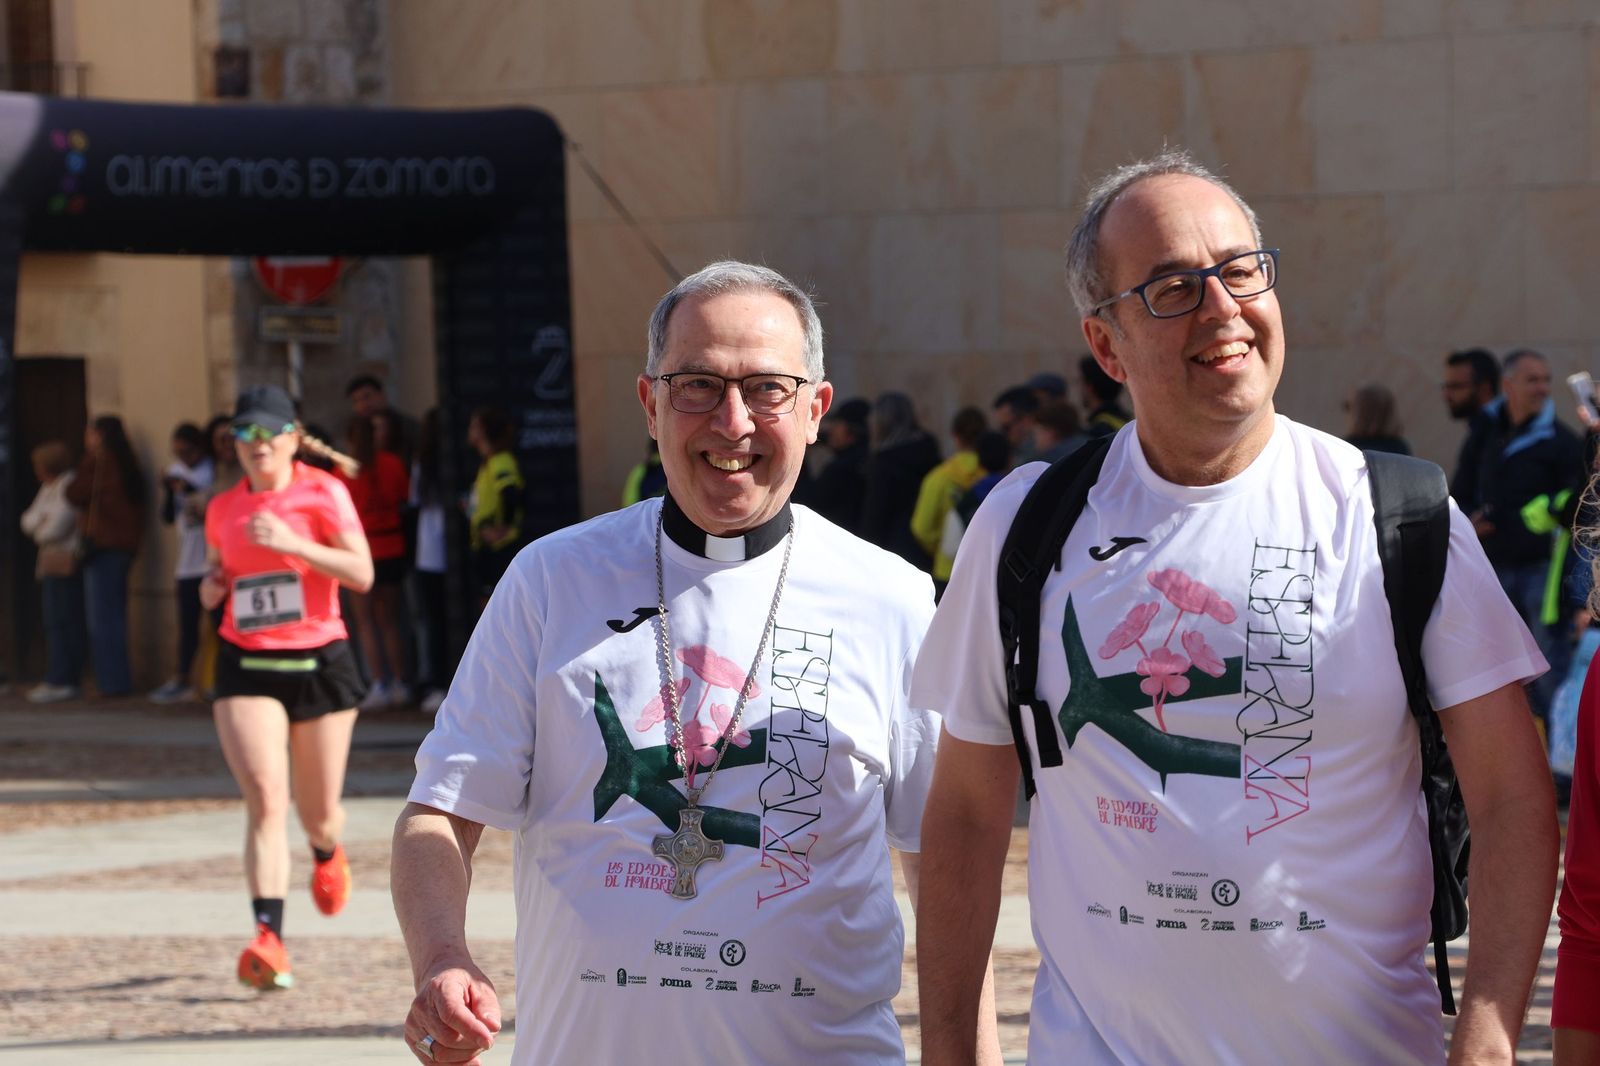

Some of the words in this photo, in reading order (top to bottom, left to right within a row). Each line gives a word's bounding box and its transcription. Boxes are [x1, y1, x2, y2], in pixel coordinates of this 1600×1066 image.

[105, 153, 300, 198] alimentos
[344, 155, 497, 199] zamora
[251, 586, 278, 613] 61
[1111, 799, 1159, 816] EDADES
[1113, 812, 1158, 833] HOMBRE
[606, 861, 624, 875] LAS
[627, 862, 677, 879] EDADES
[624, 875, 673, 894] HOMBRE
[683, 929, 719, 937] ORGANIZAN
[1260, 920, 1284, 928] ZAMORA
[680, 966, 718, 974] COLABORAN
